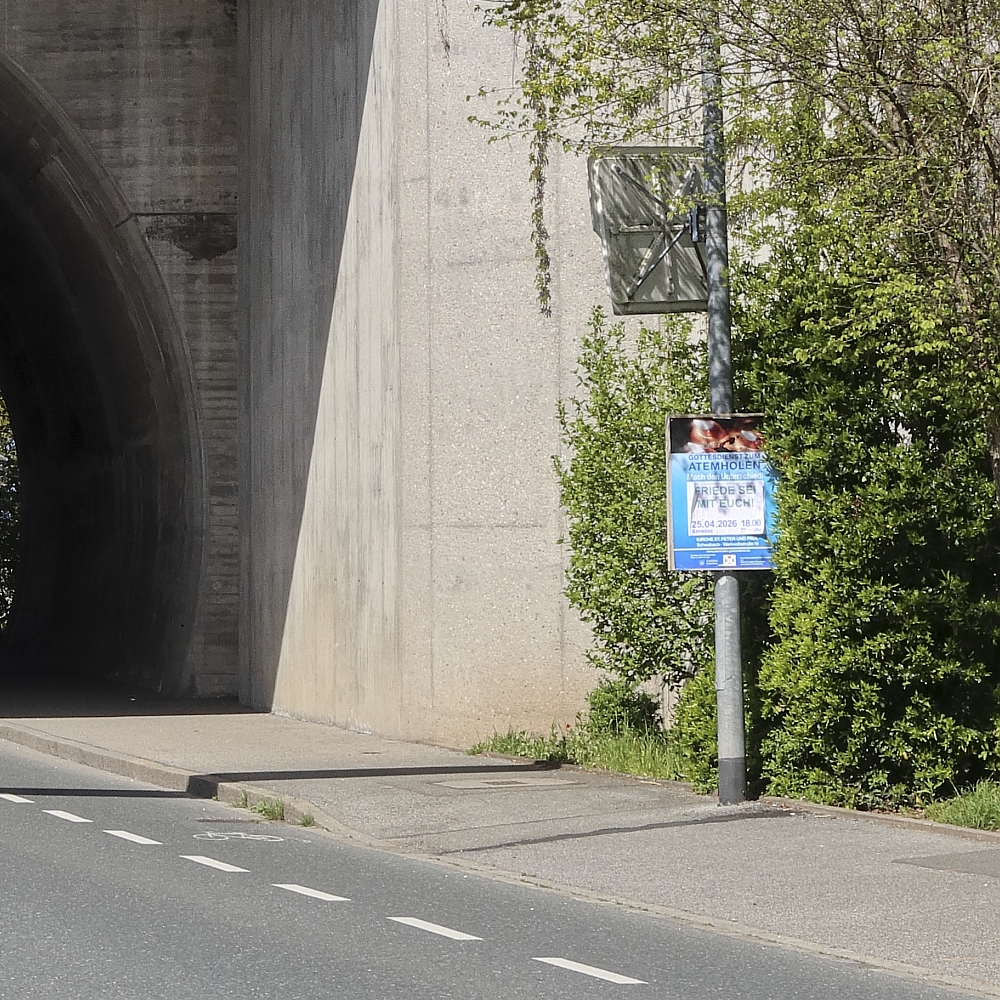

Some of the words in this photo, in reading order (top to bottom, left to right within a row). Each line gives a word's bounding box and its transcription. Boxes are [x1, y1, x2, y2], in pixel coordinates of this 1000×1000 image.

[688, 461, 761, 471] ATEMHOLEN
[695, 486, 735, 496] FRIEDE
[738, 485, 757, 495] SEI
[697, 500, 715, 508] MIT
[719, 498, 754, 508] EUCH!
[691, 520, 738, 529] 25.04.2026
[741, 519, 762, 528] 18.00
